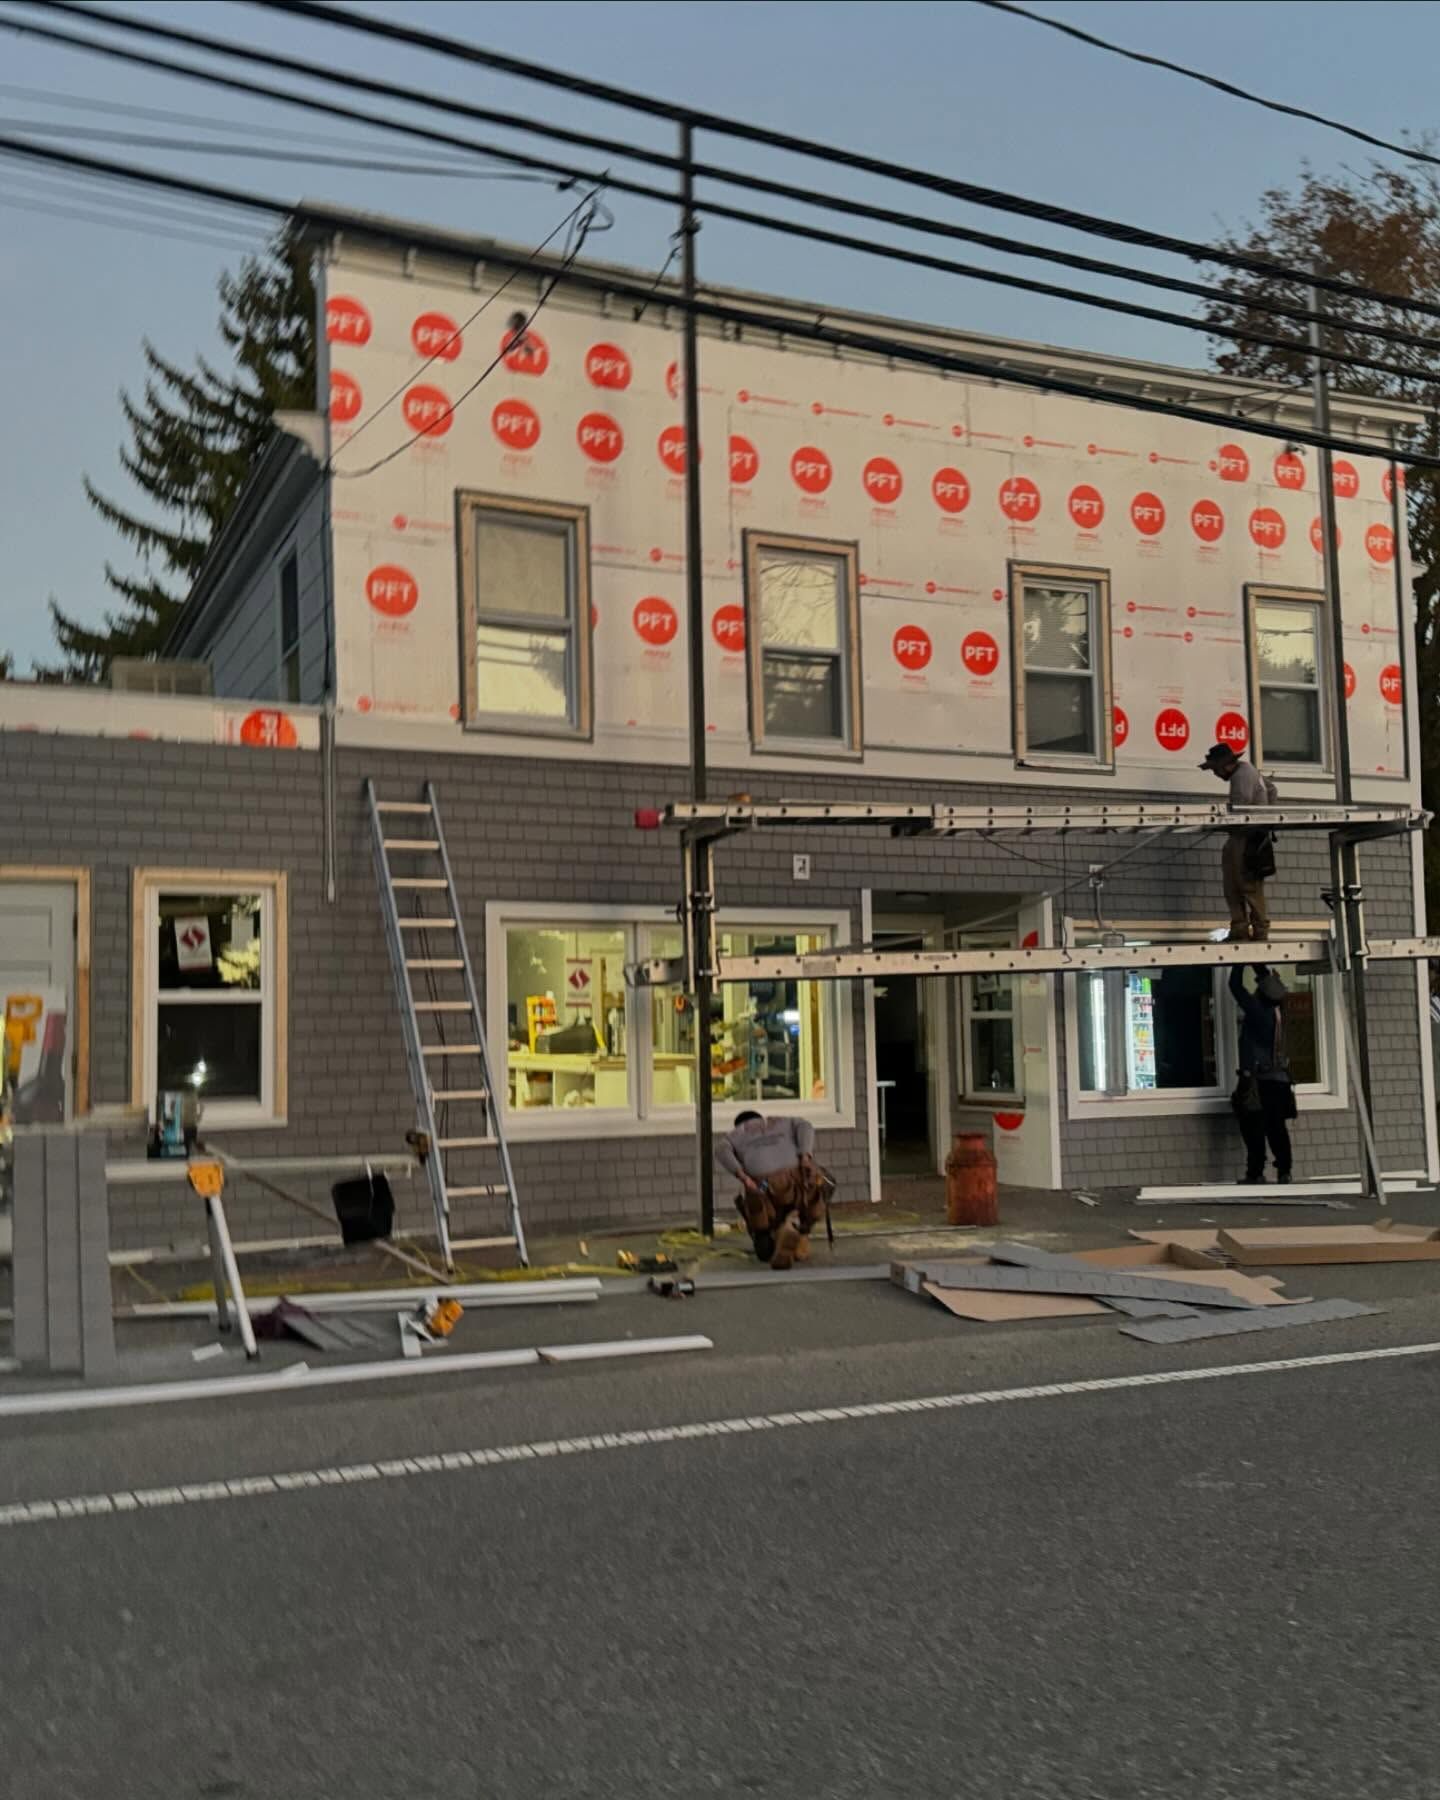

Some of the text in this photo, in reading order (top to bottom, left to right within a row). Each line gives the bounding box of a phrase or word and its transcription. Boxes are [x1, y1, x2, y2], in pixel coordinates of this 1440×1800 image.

[588, 357, 626, 378] PFT
[330, 384, 355, 408] FT
[407, 399, 449, 422] PFT
[496, 413, 536, 435] PFT
[581, 428, 619, 449] PFT
[730, 451, 755, 469] FT
[1220, 457, 1247, 474] PFT
[795, 461, 828, 479] PFT
[1276, 465, 1303, 481] PFT
[866, 472, 899, 490] PFT
[1333, 474, 1358, 489] PFT
[935, 482, 967, 498] PFT
[1003, 491, 1037, 508] PFT
[1071, 498, 1102, 514] PFT
[1134, 506, 1163, 521] PFT
[1194, 513, 1221, 529] PFT
[1367, 535, 1393, 551] PFT
[371, 578, 412, 602] PFT
[638, 611, 672, 631] PFT
[717, 620, 746, 636] PF
[896, 639, 927, 656] PFT
[964, 645, 995, 662] PFT
[1381, 677, 1402, 693] PF
[1159, 723, 1187, 738] PFT
[1219, 727, 1248, 741] PFT
